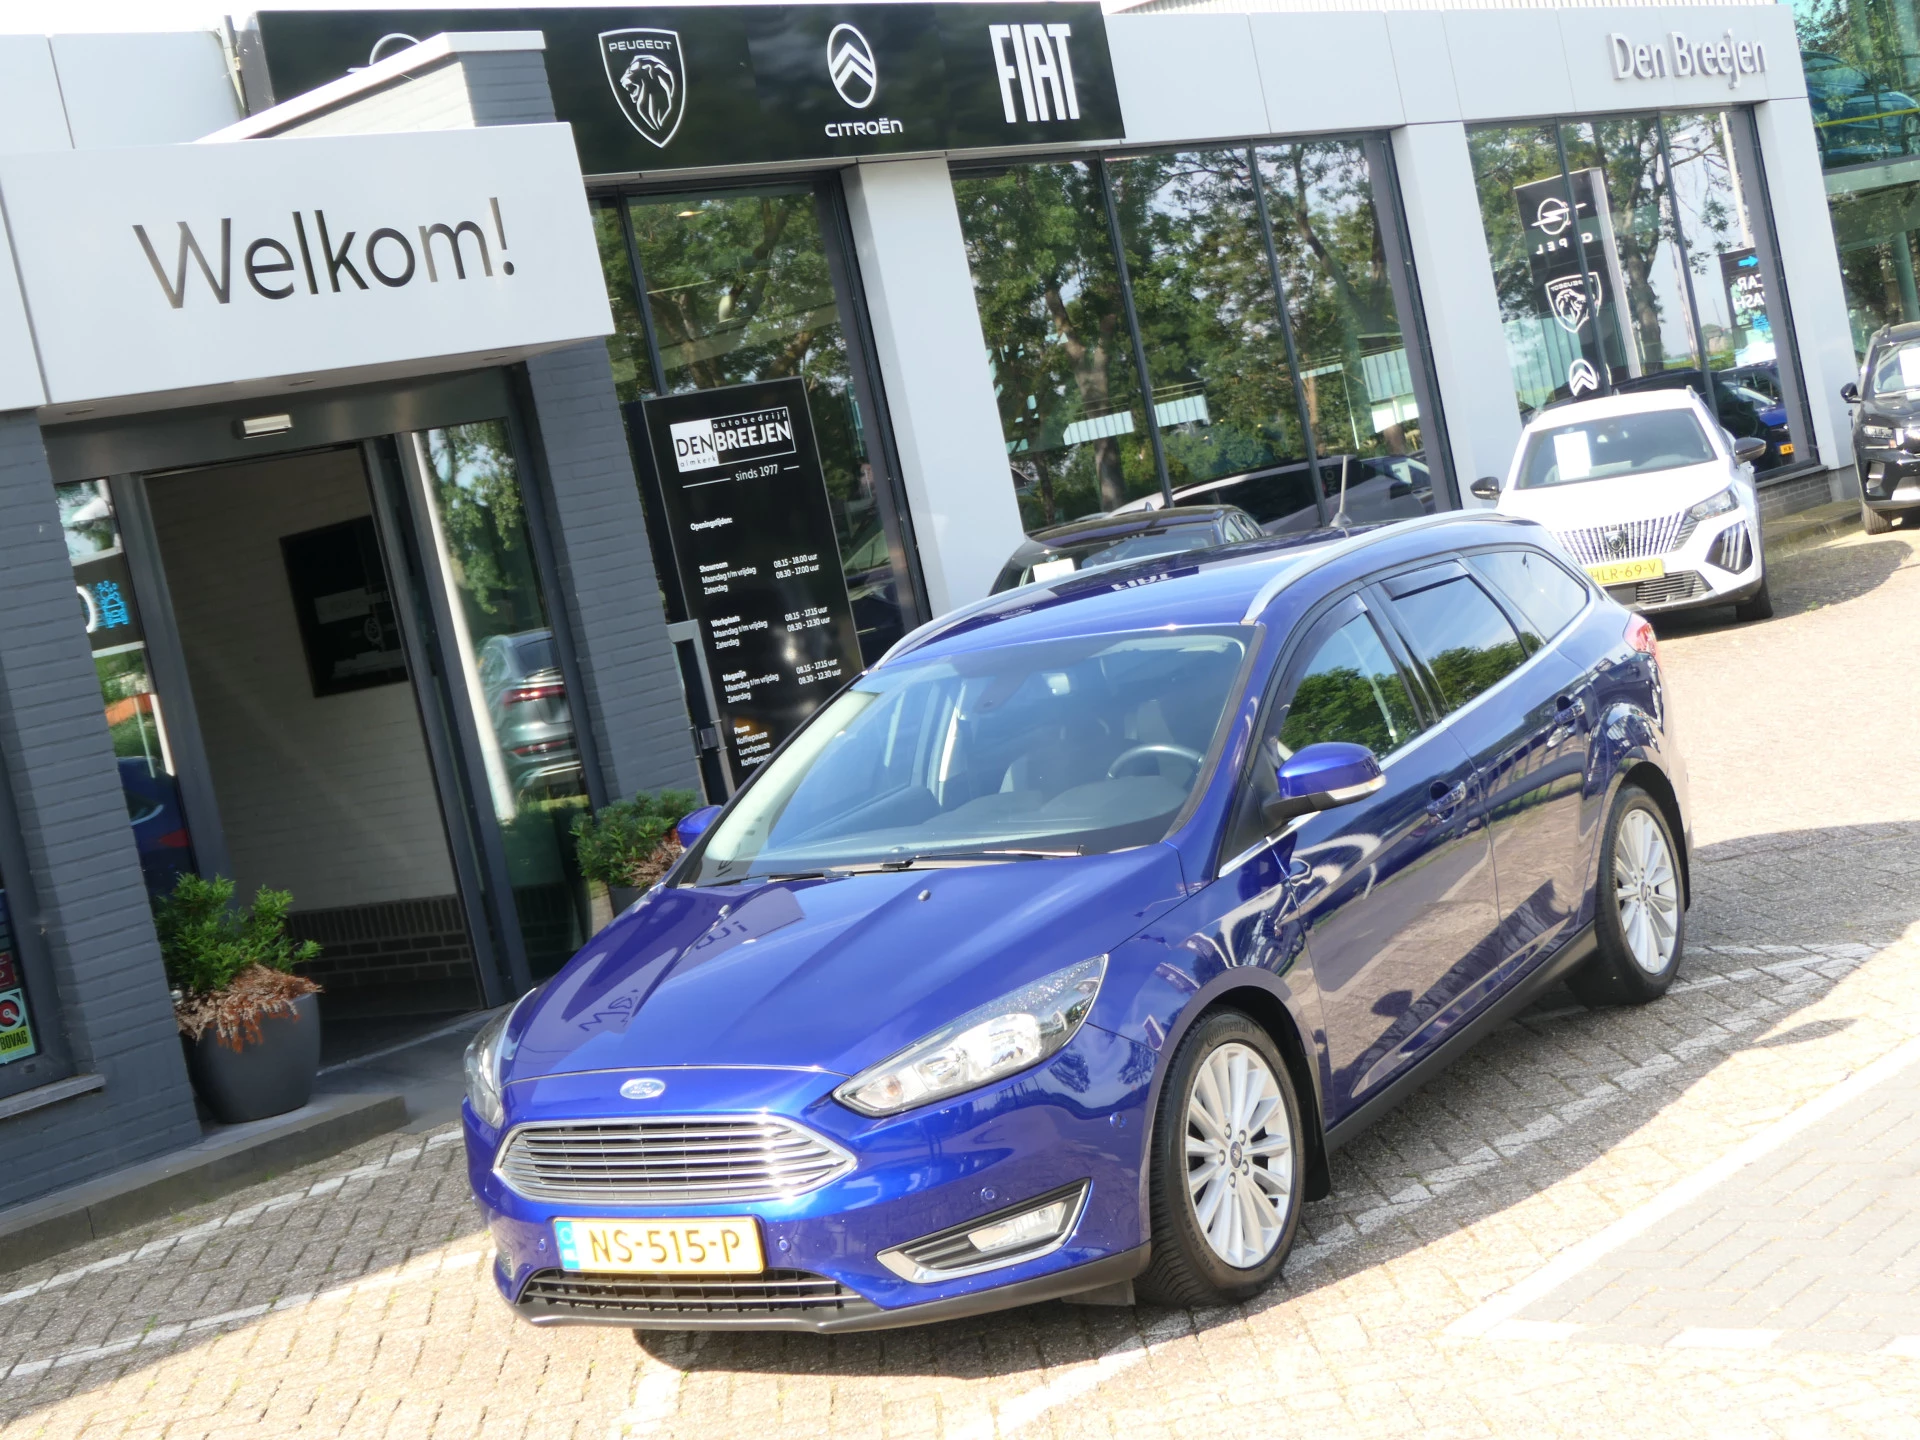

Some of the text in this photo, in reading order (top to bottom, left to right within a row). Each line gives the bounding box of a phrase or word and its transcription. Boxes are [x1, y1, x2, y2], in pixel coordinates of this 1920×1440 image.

[609, 40, 672, 52] PEUGEOT
[1606, 28, 1768, 89] Den Breejen
[989, 23, 1080, 123] FIAT
[132, 197, 515, 309] Welkom!
[713, 410, 786, 429] autobedrijf
[675, 421, 791, 457] DEN BREEJEN
[680, 456, 717, 468] almkerk
[735, 464, 778, 481] sinds 1977
[699, 562, 728, 573] Showroom
[773, 558, 788, 568] 08.15
[808, 553, 817, 561] uur
[702, 566, 757, 584] Maandag t/m vrijdag
[776, 569, 791, 579] 08.30
[704, 584, 728, 595] Zaterdag
[784, 611, 800, 621] 08.15
[818, 606, 828, 614] uur
[711, 615, 740, 627] Werkplaats
[787, 622, 802, 632] 08.30
[713, 627, 738, 638] Maandag
[749, 620, 768, 630] vrijdag
[715, 639, 740, 650] Zaterdag
[722, 669, 746, 682] Magazijn
[796, 664, 811, 674] 08.15
[725, 673, 779, 692] Maandag t/m vrijdag
[798, 674, 814, 685] 08.30
[727, 692, 752, 704] Zaterdag
[736, 731, 768, 745] Koffiepauze
[738, 742, 771, 756] Lunchpauze
[0, 1030, 28, 1050] BOVAG
[589, 1229, 740, 1263] NS-515-P
